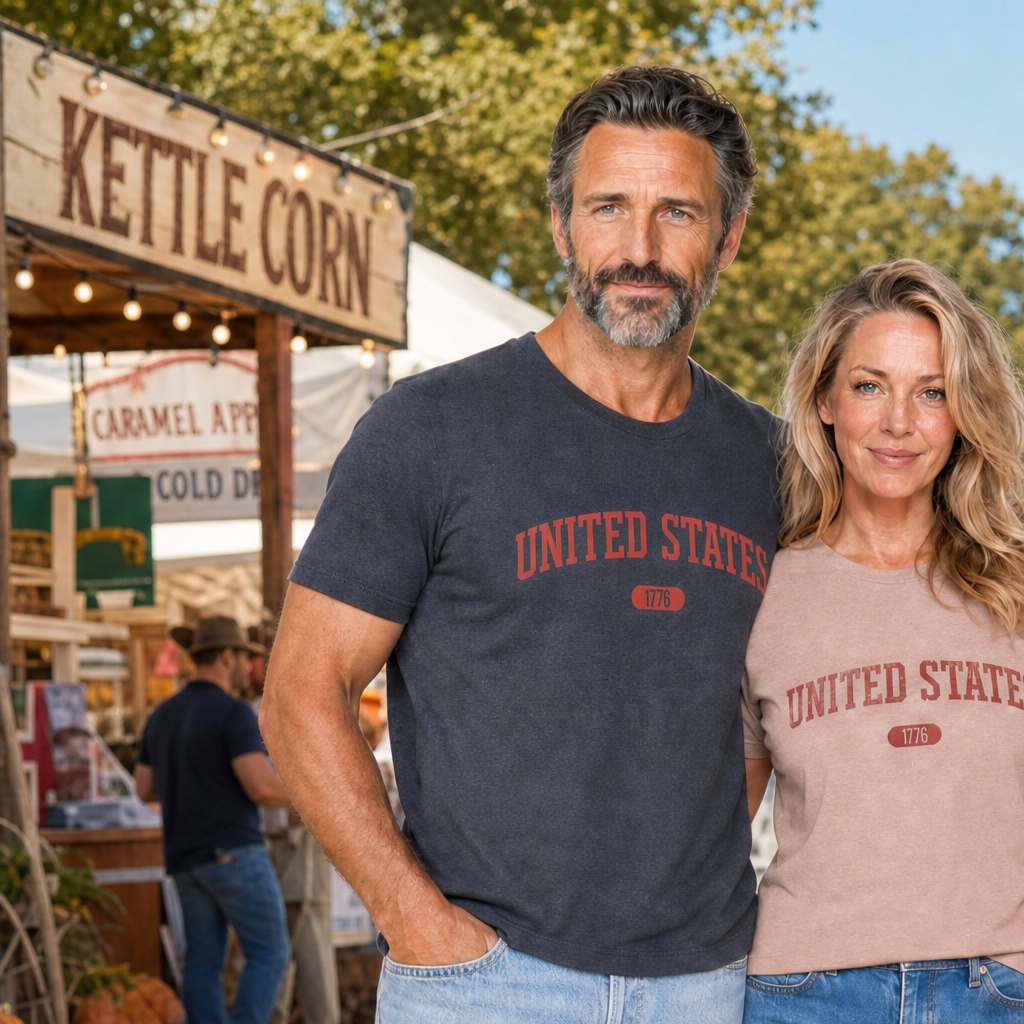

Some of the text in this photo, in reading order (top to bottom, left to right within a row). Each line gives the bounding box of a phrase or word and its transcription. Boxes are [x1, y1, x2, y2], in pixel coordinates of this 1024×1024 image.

[58, 96, 372, 318] KETTLE CORN
[92, 404, 203, 440] CARAMEL
[157, 468, 223, 500] COLD
[515, 511, 768, 596] UNITED STATES
[645, 588, 671, 608] 1776
[786, 661, 907, 729] UNITED
[901, 726, 929, 745] 1776
